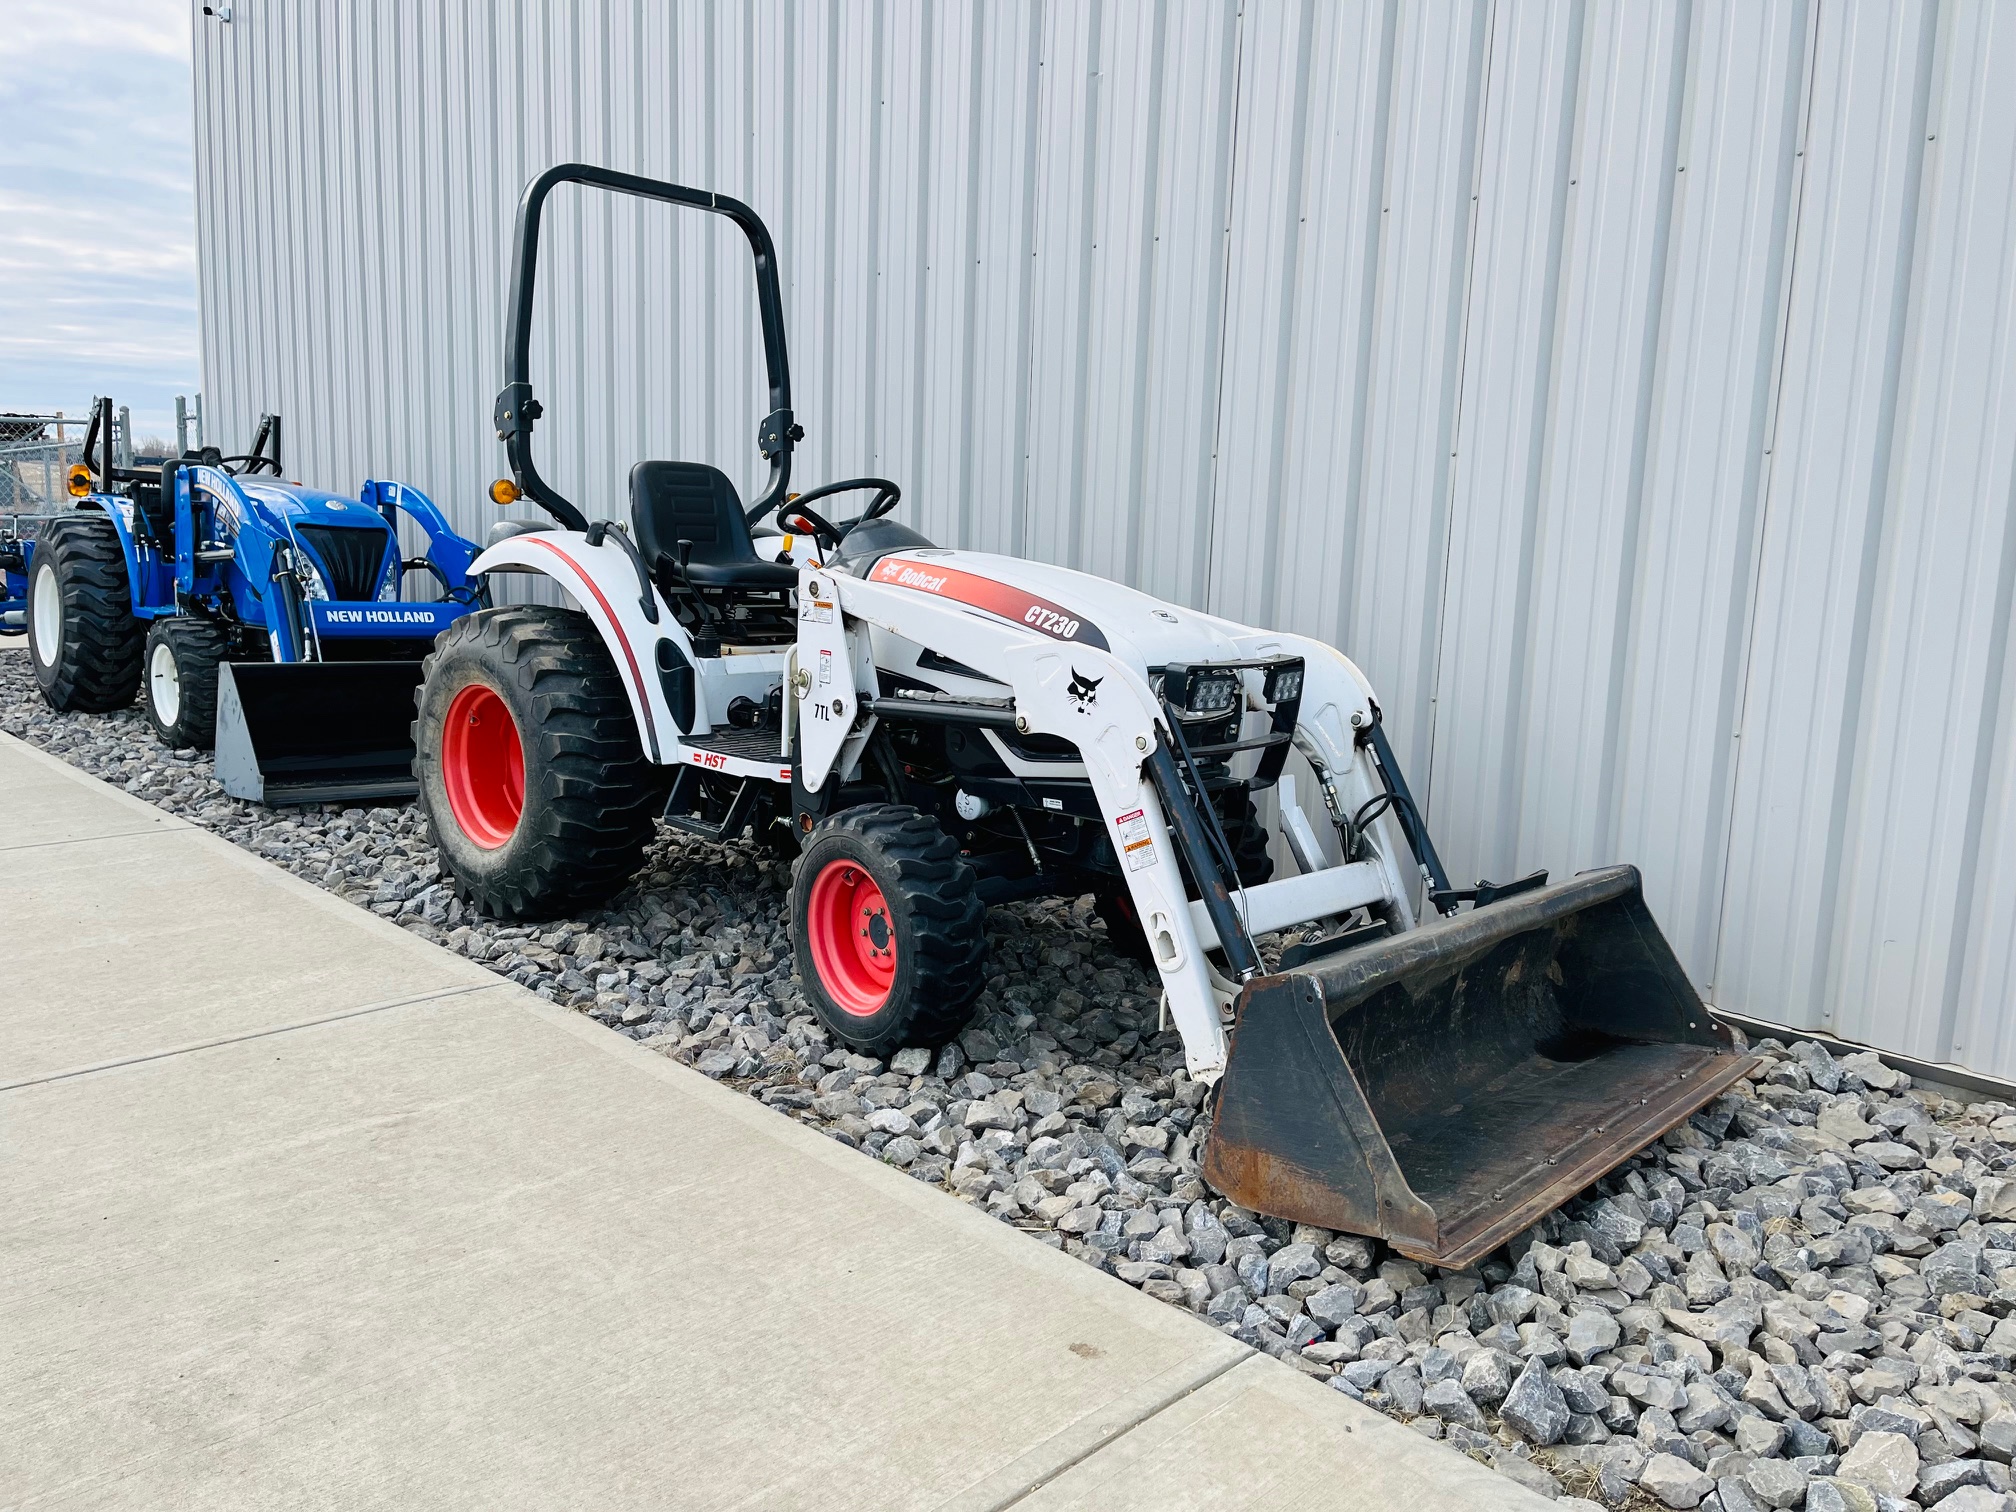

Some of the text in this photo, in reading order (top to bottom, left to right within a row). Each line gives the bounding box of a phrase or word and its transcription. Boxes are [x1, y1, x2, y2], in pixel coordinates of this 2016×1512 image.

[897, 568, 947, 592] Bobcat
[326, 611, 435, 623] NEW HOLLAND
[1024, 605, 1080, 639] CT230
[814, 703, 829, 721] 7TL
[704, 753, 727, 769] HST
